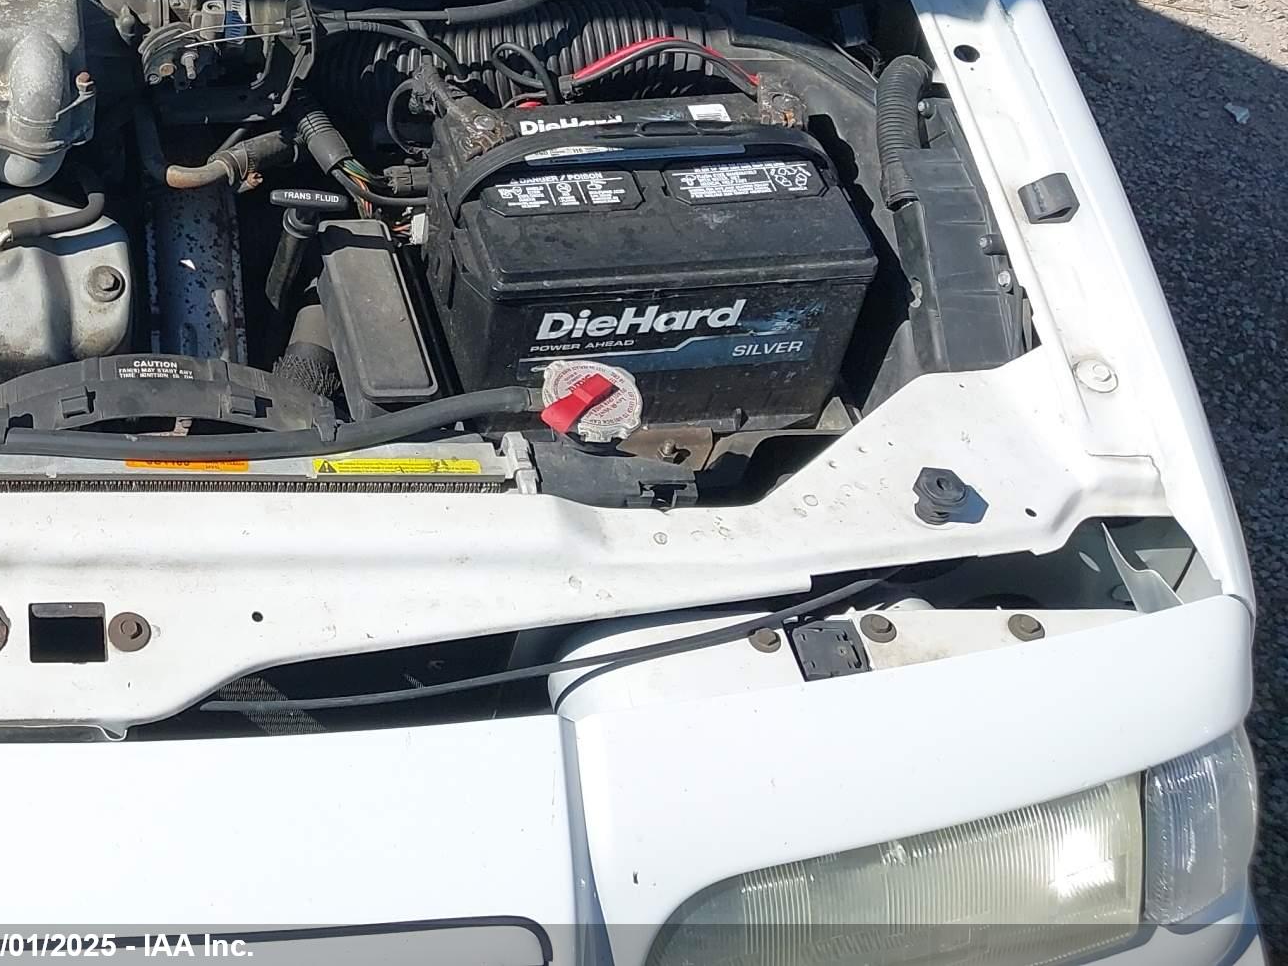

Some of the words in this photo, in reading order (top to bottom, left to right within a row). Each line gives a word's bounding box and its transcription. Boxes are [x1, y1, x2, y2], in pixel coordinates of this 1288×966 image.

[566, 172, 603, 181] POISON
[283, 191, 311, 200] TRANS
[315, 193, 339, 203] FLUID
[535, 299, 747, 341] DieHard
[530, 342, 580, 353] POWER
[585, 339, 634, 349] AHEAD
[732, 340, 803, 358] SILVER
[133, 360, 178, 368] CAUTION
